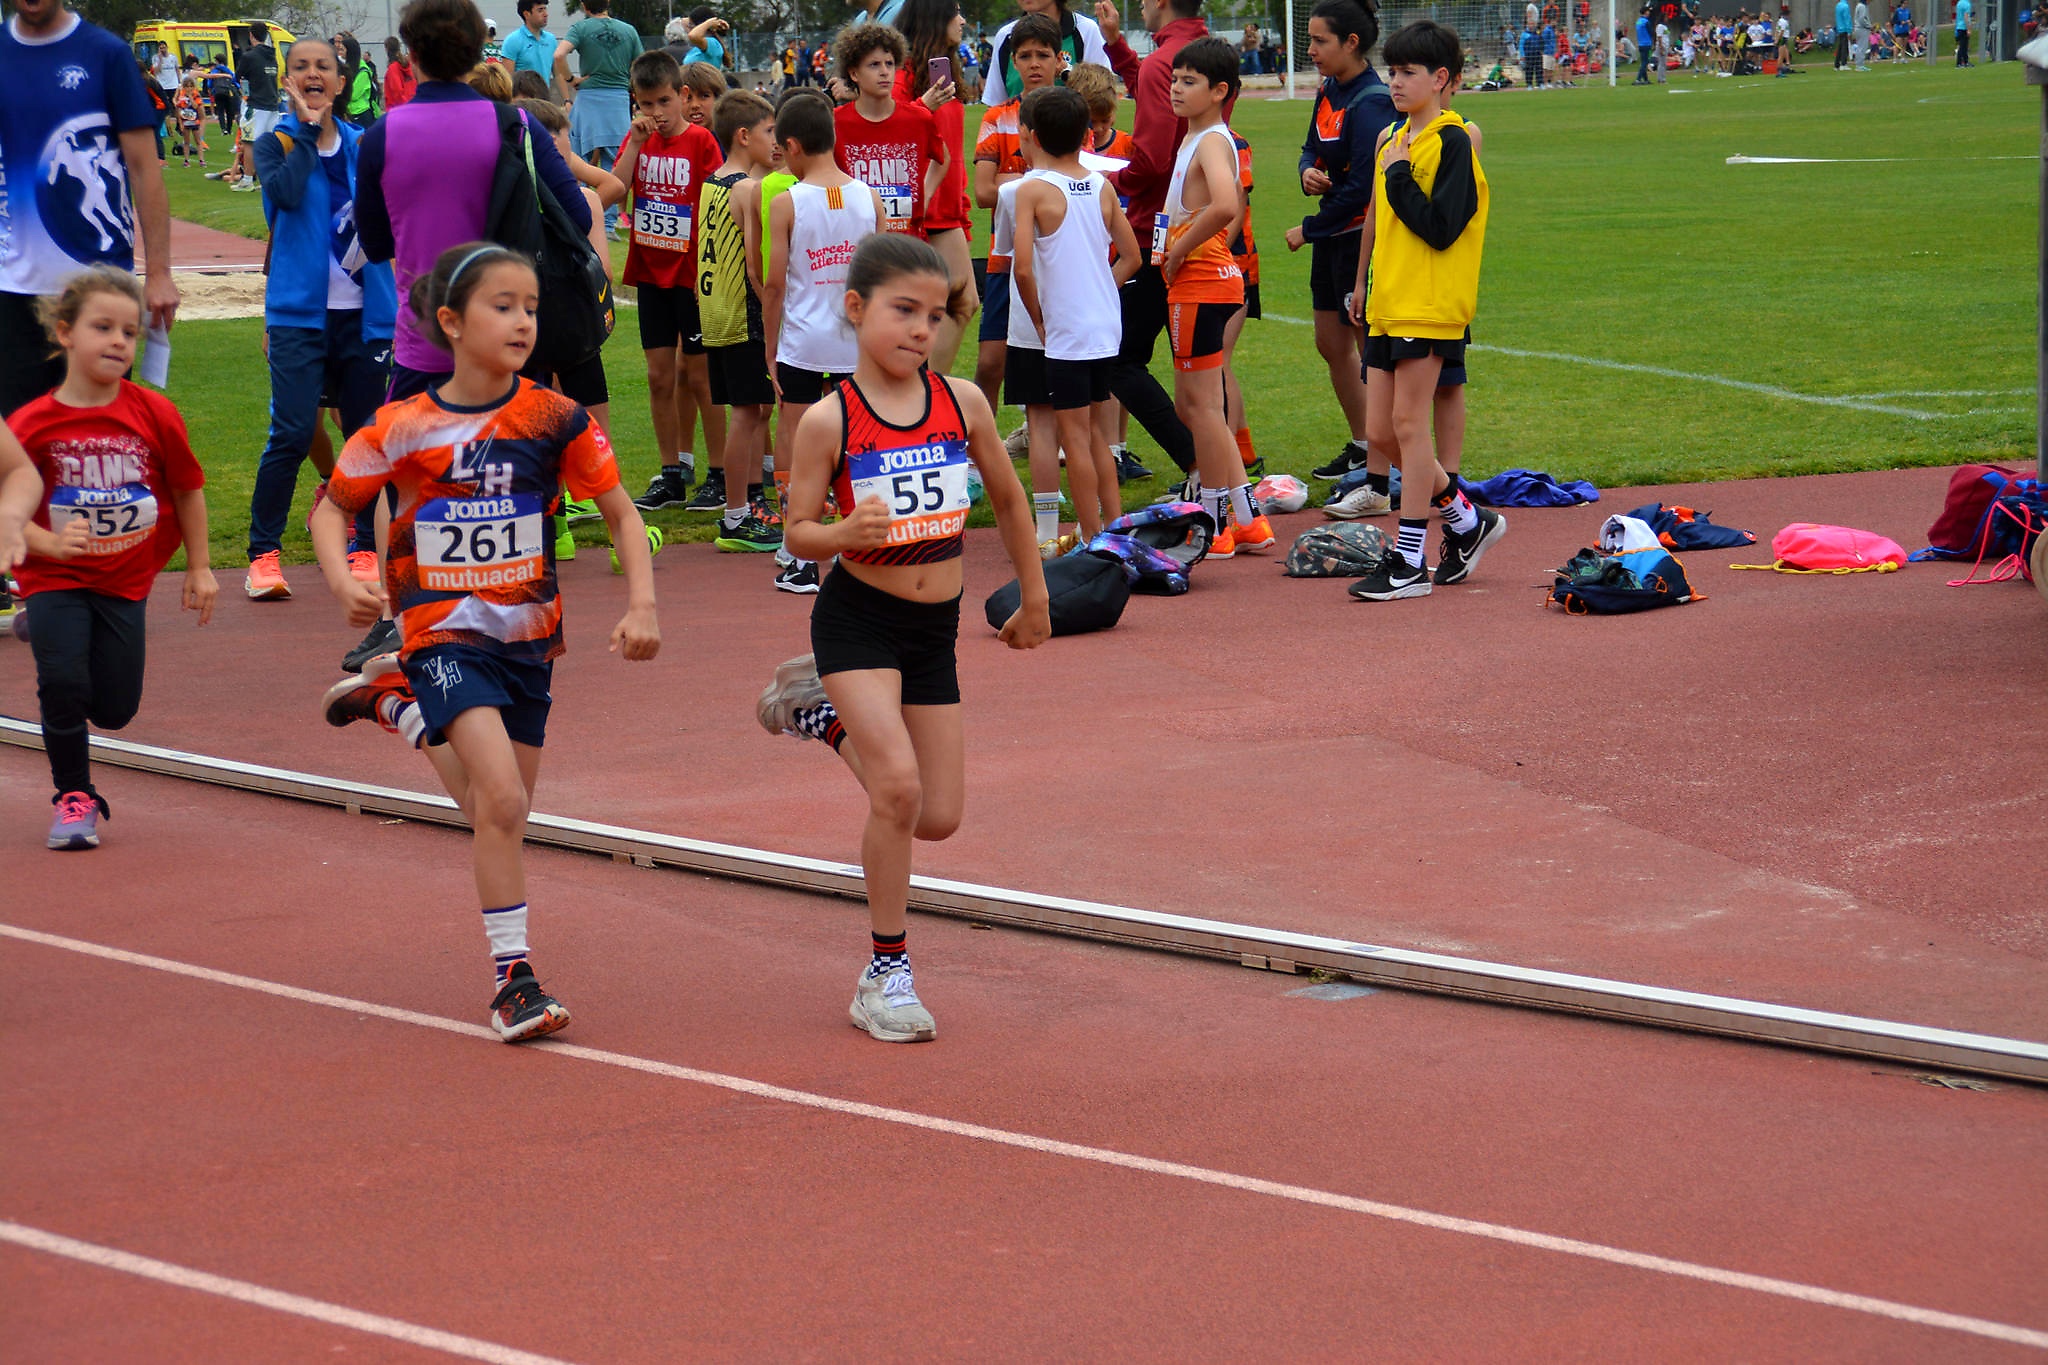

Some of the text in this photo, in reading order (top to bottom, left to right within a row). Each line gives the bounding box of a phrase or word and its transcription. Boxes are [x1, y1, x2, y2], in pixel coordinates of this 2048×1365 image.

[638, 154, 690, 186] CANB
[854, 159, 909, 185] CANB
[1069, 181, 1091, 191] UGE
[645, 201, 677, 214] Joma
[641, 212, 679, 237] 353
[636, 236, 685, 251] mutuacat
[879, 445, 946, 474] Joma
[75, 488, 132, 506] Joma
[892, 471, 944, 515] 55
[444, 498, 516, 521] Joma
[886, 511, 965, 543] utuacat
[439, 520, 522, 563] 261
[427, 560, 535, 589] mutuacat
